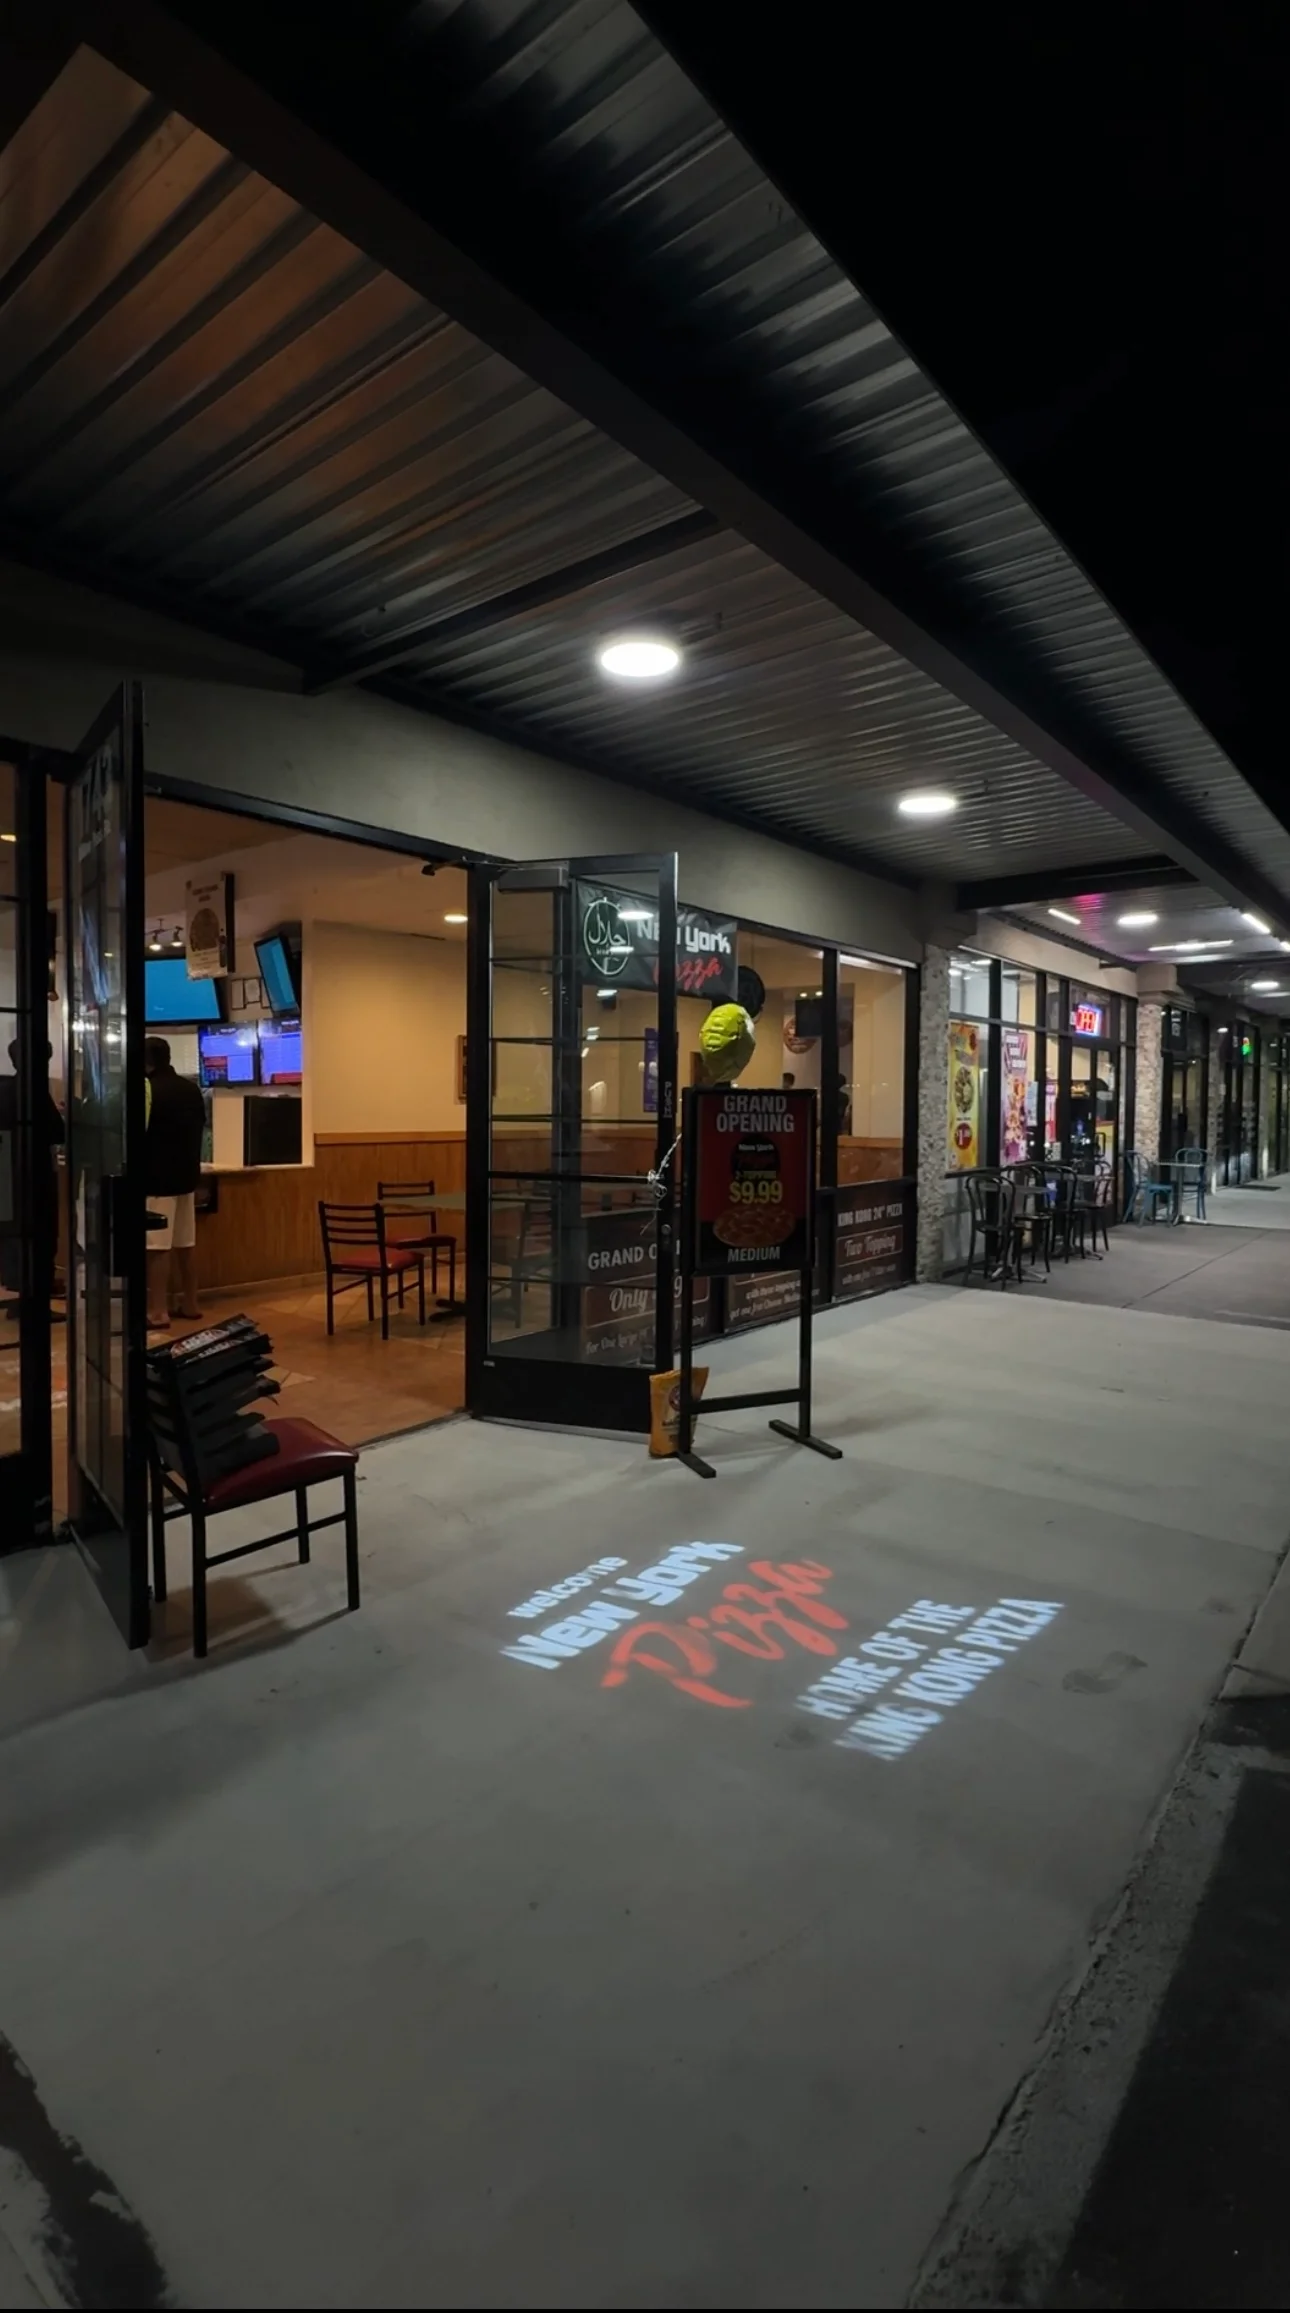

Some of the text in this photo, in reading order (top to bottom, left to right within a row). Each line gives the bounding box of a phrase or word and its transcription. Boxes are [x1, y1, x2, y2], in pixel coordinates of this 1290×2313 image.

[723, 1094, 787, 1113] GRAND
[716, 1113, 795, 1133] OPENING
[729, 1180, 783, 1204] $9.99
[587, 1246, 644, 1270] GRAND
[727, 1247, 781, 1263] MEDIUM
[609, 1288, 649, 1312] Only
[500, 1601, 640, 1670] New
[601, 1559, 849, 1708] Pizza
[794, 1599, 976, 1720] HOME OF THE
[832, 1598, 1065, 1762] KING KONG PIZZA
